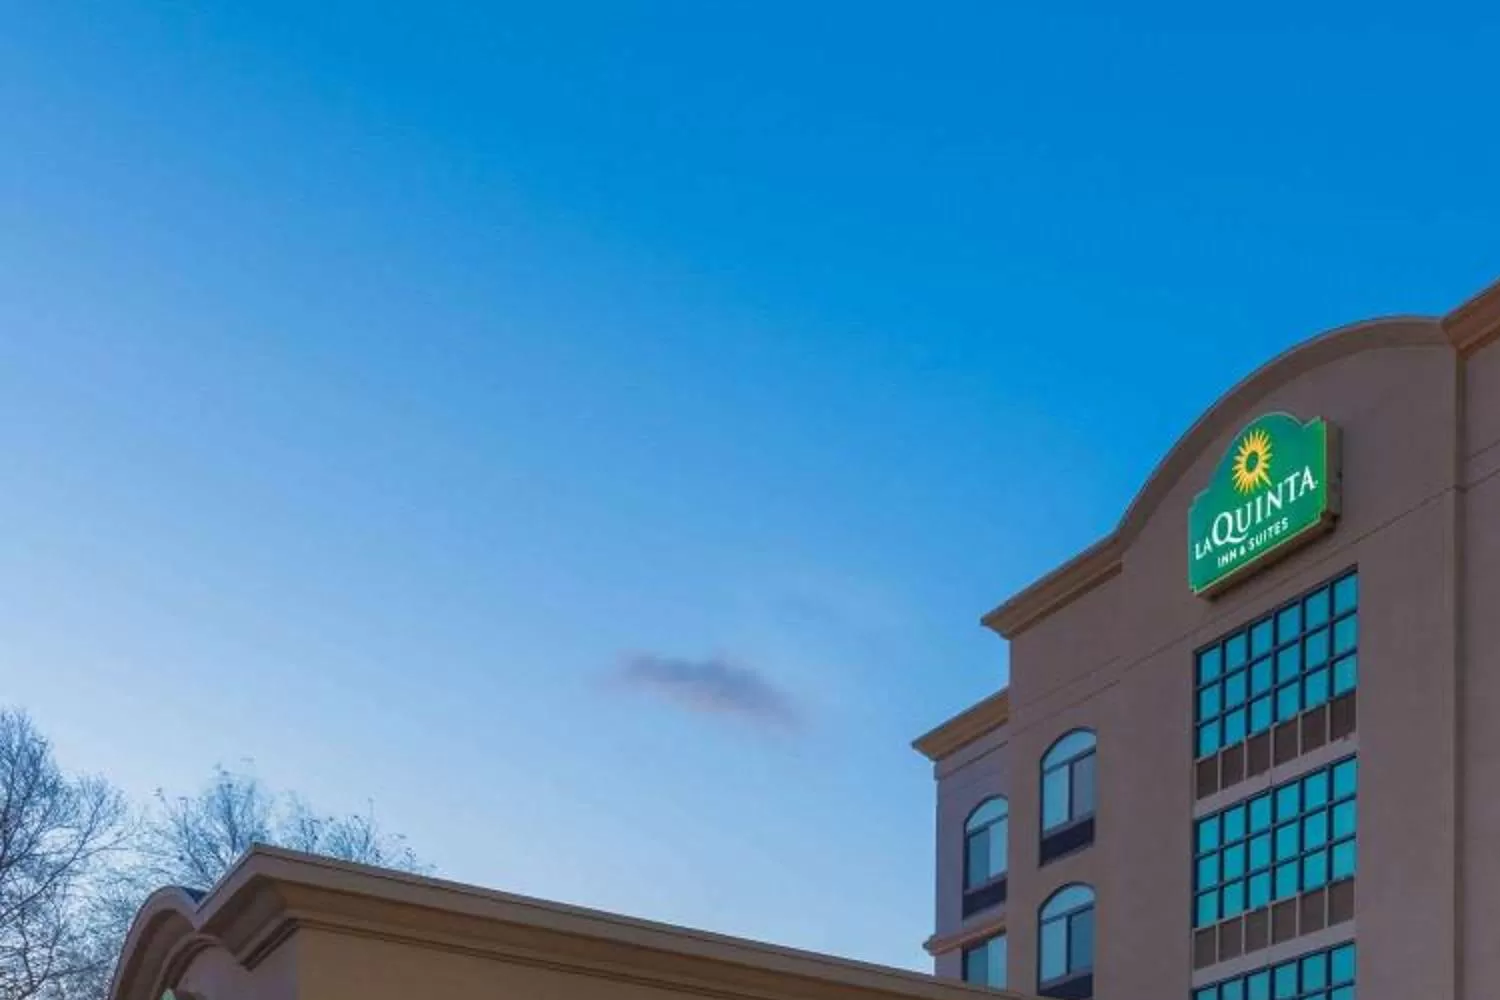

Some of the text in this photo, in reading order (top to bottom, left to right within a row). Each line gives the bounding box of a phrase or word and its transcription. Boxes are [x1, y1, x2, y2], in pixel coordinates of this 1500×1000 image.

[1195, 465, 1317, 560] LA QUINTA
[1217, 547, 1237, 568] INN
[1249, 517, 1289, 550] SUITES
